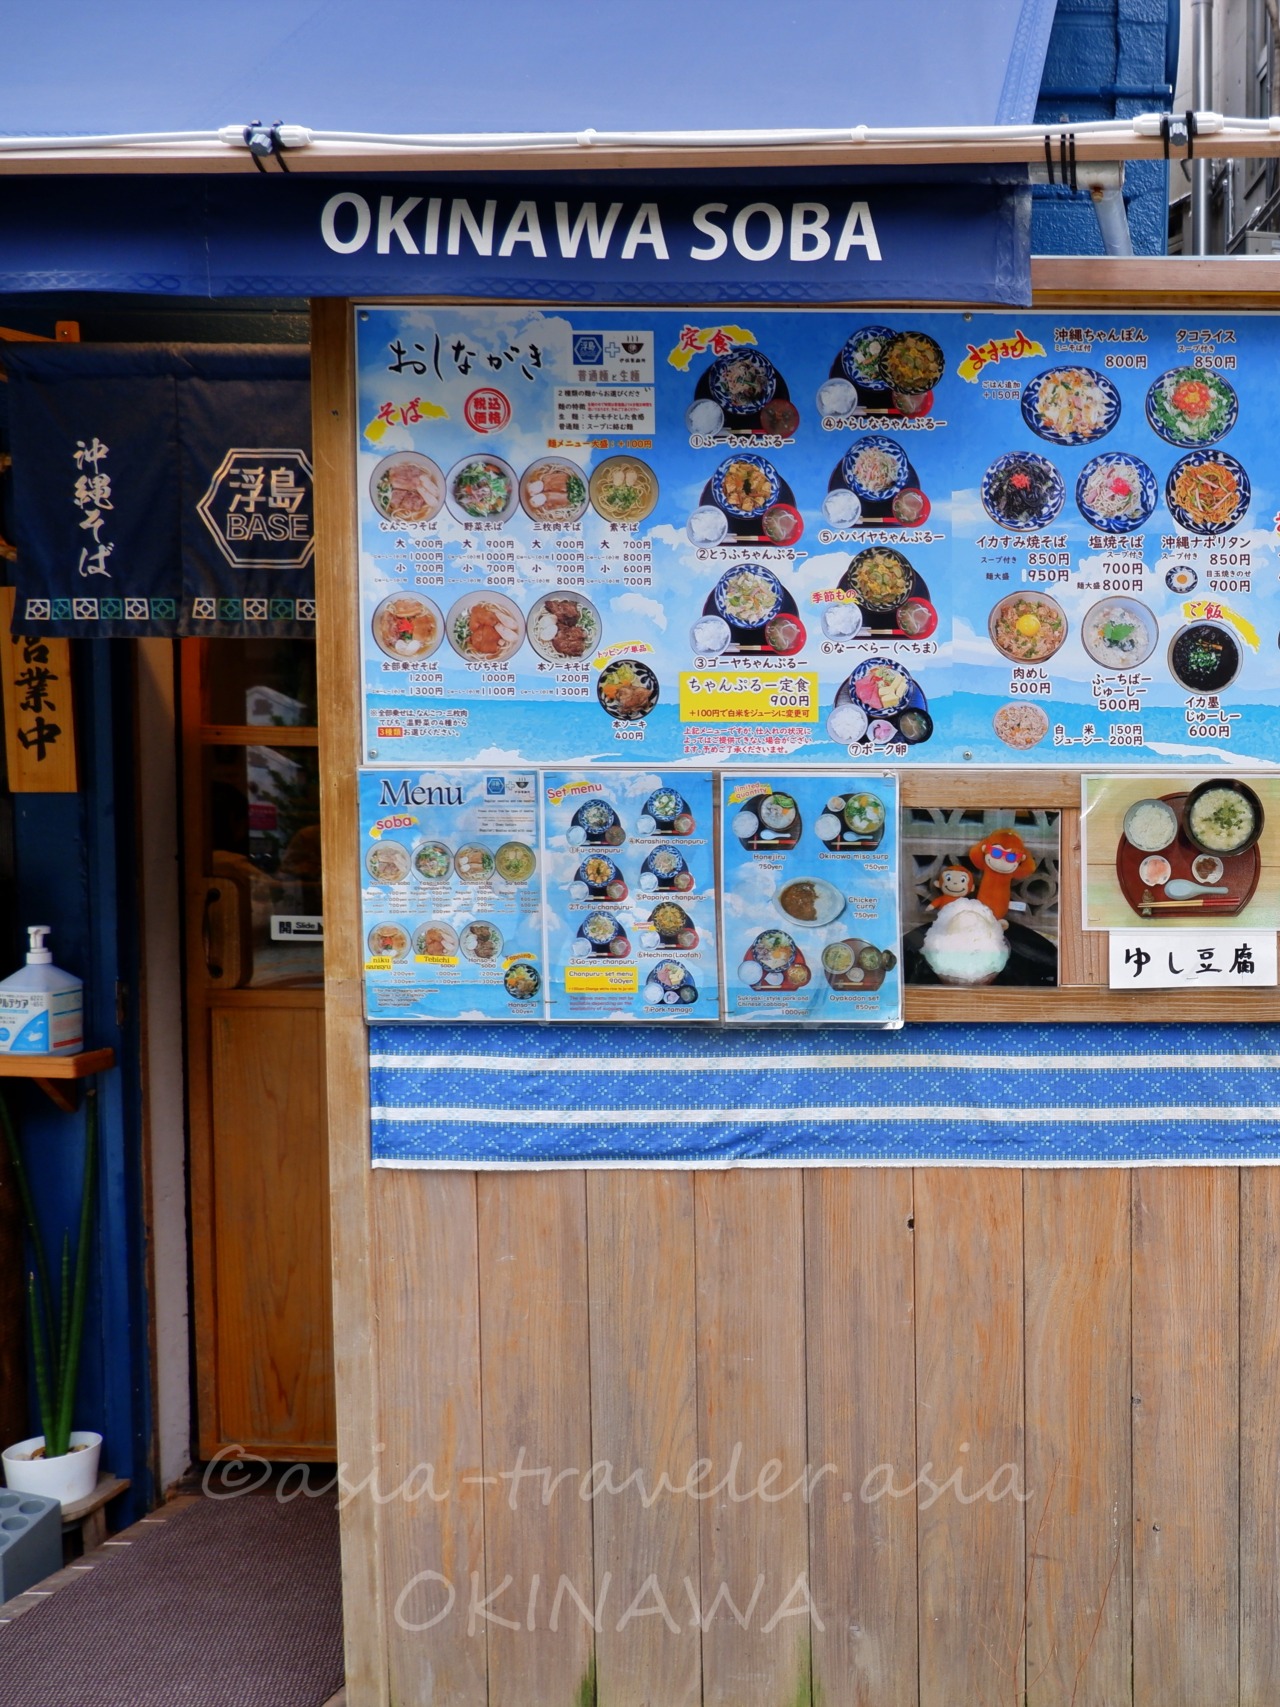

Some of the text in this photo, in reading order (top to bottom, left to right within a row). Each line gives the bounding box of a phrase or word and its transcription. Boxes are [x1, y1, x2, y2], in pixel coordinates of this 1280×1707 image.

[320, 190, 882, 264] OKINAWA SOBA
[680, 326, 733, 354] 定食
[1054, 328, 1149, 343] 沖縄ちゃんぽん
[1176, 329, 1236, 343] タコライス
[1054, 344, 1092, 352] ミニそば付
[1177, 345, 1215, 353] スープ付き
[389, 334, 542, 381] おしながき
[1105, 356, 1147, 368] 800円
[1194, 356, 1236, 369] 850円
[982, 381, 1021, 389] ごはん追加
[983, 391, 1020, 400] +150円
[474, 397, 501, 411] 税込
[377, 398, 422, 426] そば
[474, 412, 501, 425] 価格
[228, 466, 306, 513] 浮島
[73, 438, 114, 578] 沖縄そば
[226, 514, 311, 542] BASE
[380, 522, 438, 530] なんこつそば
[464, 522, 503, 531] 野菜そば
[533, 523, 581, 532] 三枚肉そば
[610, 523, 638, 532] 素そば
[415, 540, 443, 548] 900円
[976, 536, 1067, 549] イカすみ焼そば
[1088, 536, 1144, 549] 塩焼そば
[1162, 537, 1251, 549] 沖縄ナポリタン
[980, 553, 1069, 566] スープ付き 850円
[1107, 551, 1143, 559] スープ付き
[1162, 552, 1251, 566] スープ付き 850円
[1103, 562, 1143, 575] 700円
[1206, 570, 1251, 578] 目玉焼きのせ
[1028, 570, 1069, 582] 950円
[1102, 580, 1143, 592] 800円
[1209, 580, 1251, 593] 900円
[812, 589, 856, 604] 季節もの
[1189, 602, 1223, 619] ご飯
[598, 645, 647, 658] トッピング単品
[382, 662, 438, 671] 全部乗せそば
[465, 662, 509, 671] てびちそば
[537, 663, 590, 671] 本ソーキそば
[410, 674, 443, 682] 1200円
[482, 674, 516, 682] 1000円
[1013, 667, 1048, 679] 肉めし
[689, 678, 810, 692] ちゃんぷるー定食
[1092, 674, 1152, 685] ふーちばー
[410, 687, 443, 695] 1300円
[556, 688, 588, 696] 1300円
[1010, 682, 1051, 694] 500円
[1092, 686, 1146, 696] じゅーしー
[770, 695, 810, 707] 900円
[1099, 699, 1140, 710] 500円
[1185, 696, 1220, 709] イカ墨
[1185, 710, 1240, 722] じゅーしー
[613, 721, 646, 729] 本ソーキ
[1110, 724, 1142, 735] 150円
[1189, 725, 1230, 737] 600円
[616, 732, 643, 740] 400円
[1054, 735, 1143, 746] ジューシー 200円
[380, 780, 464, 805] Menu
[547, 784, 602, 799] Set menu
[734, 783, 760, 792] limited
[736, 788, 767, 799] quantity
[376, 816, 412, 830] soba
[296, 921, 315, 929] Slide
[1124, 943, 1255, 978] ゆし豆腐
